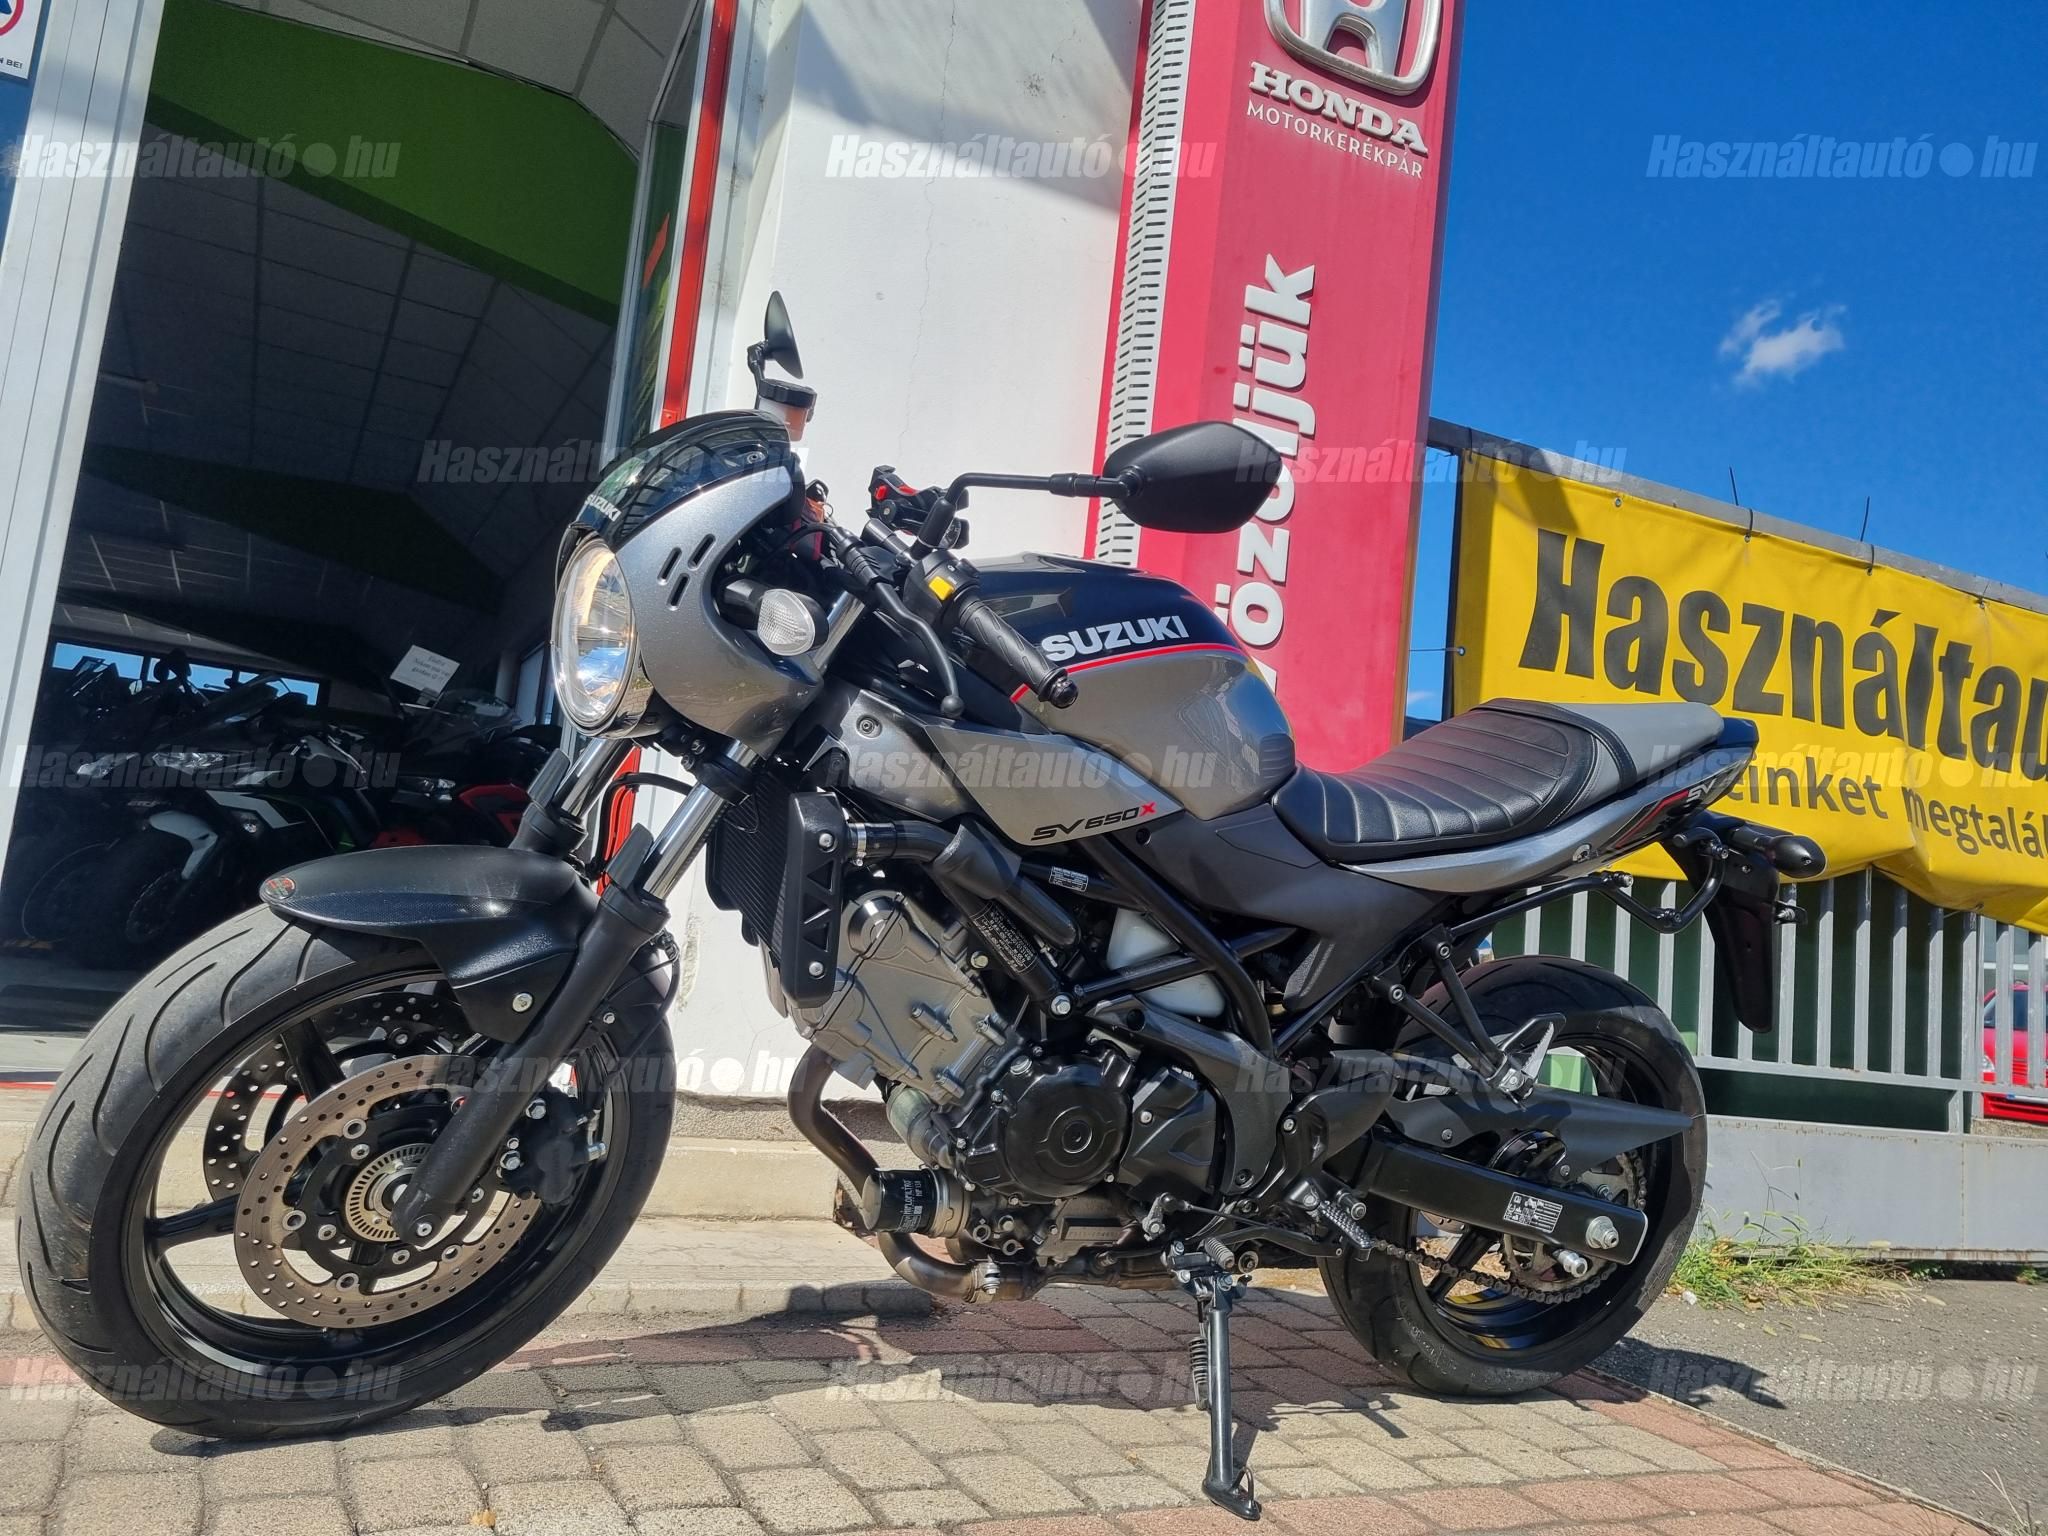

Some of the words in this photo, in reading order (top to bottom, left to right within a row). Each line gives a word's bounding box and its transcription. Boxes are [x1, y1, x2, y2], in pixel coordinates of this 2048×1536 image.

[1246, 99, 1423, 179] MOTORKERÉKPÁR
[1249, 61, 1428, 156] HONDA
[586, 494, 622, 522] SUZUKI
[1041, 615, 1189, 662] SUZUKI
